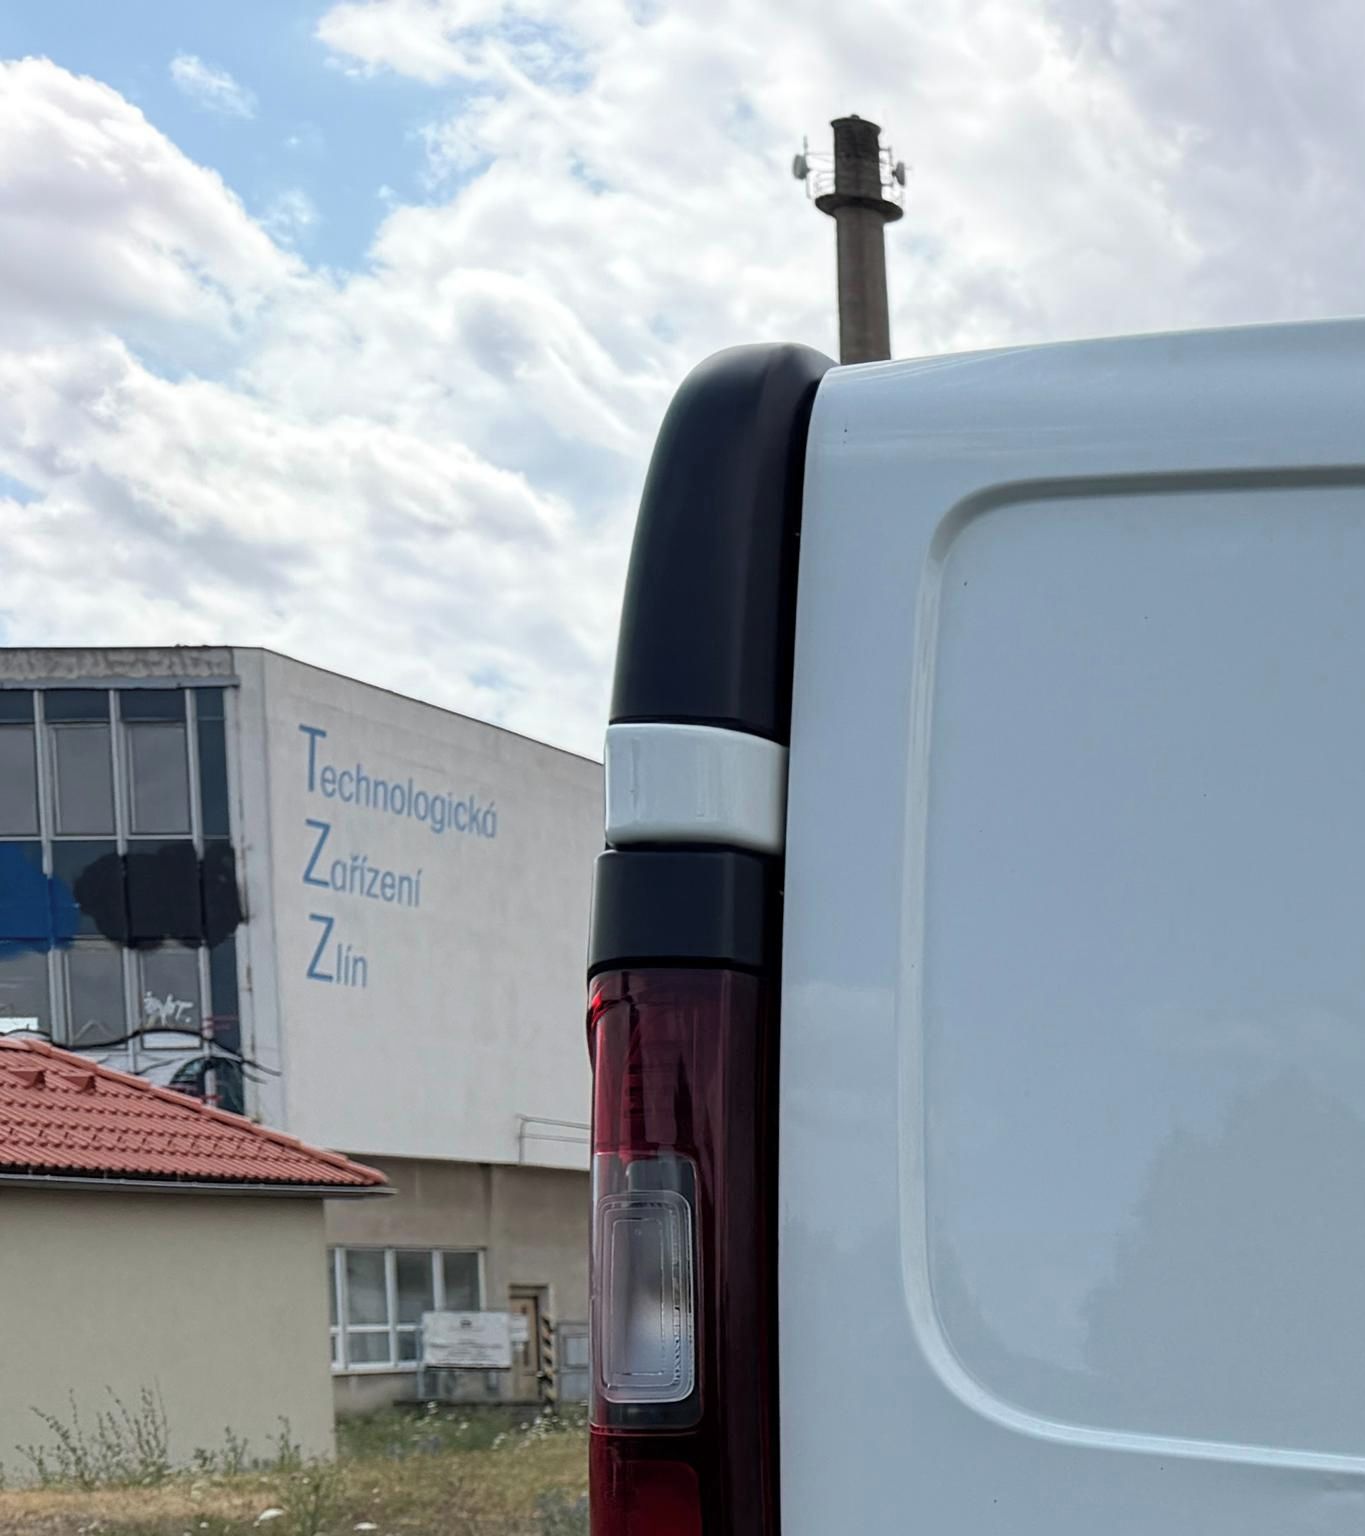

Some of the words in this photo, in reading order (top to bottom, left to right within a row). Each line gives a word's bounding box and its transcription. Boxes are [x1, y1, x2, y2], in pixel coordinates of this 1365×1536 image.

[298, 724, 498, 839] Technologická
[303, 818, 422, 907] Zařízení
[306, 913, 368, 988] Zlín
